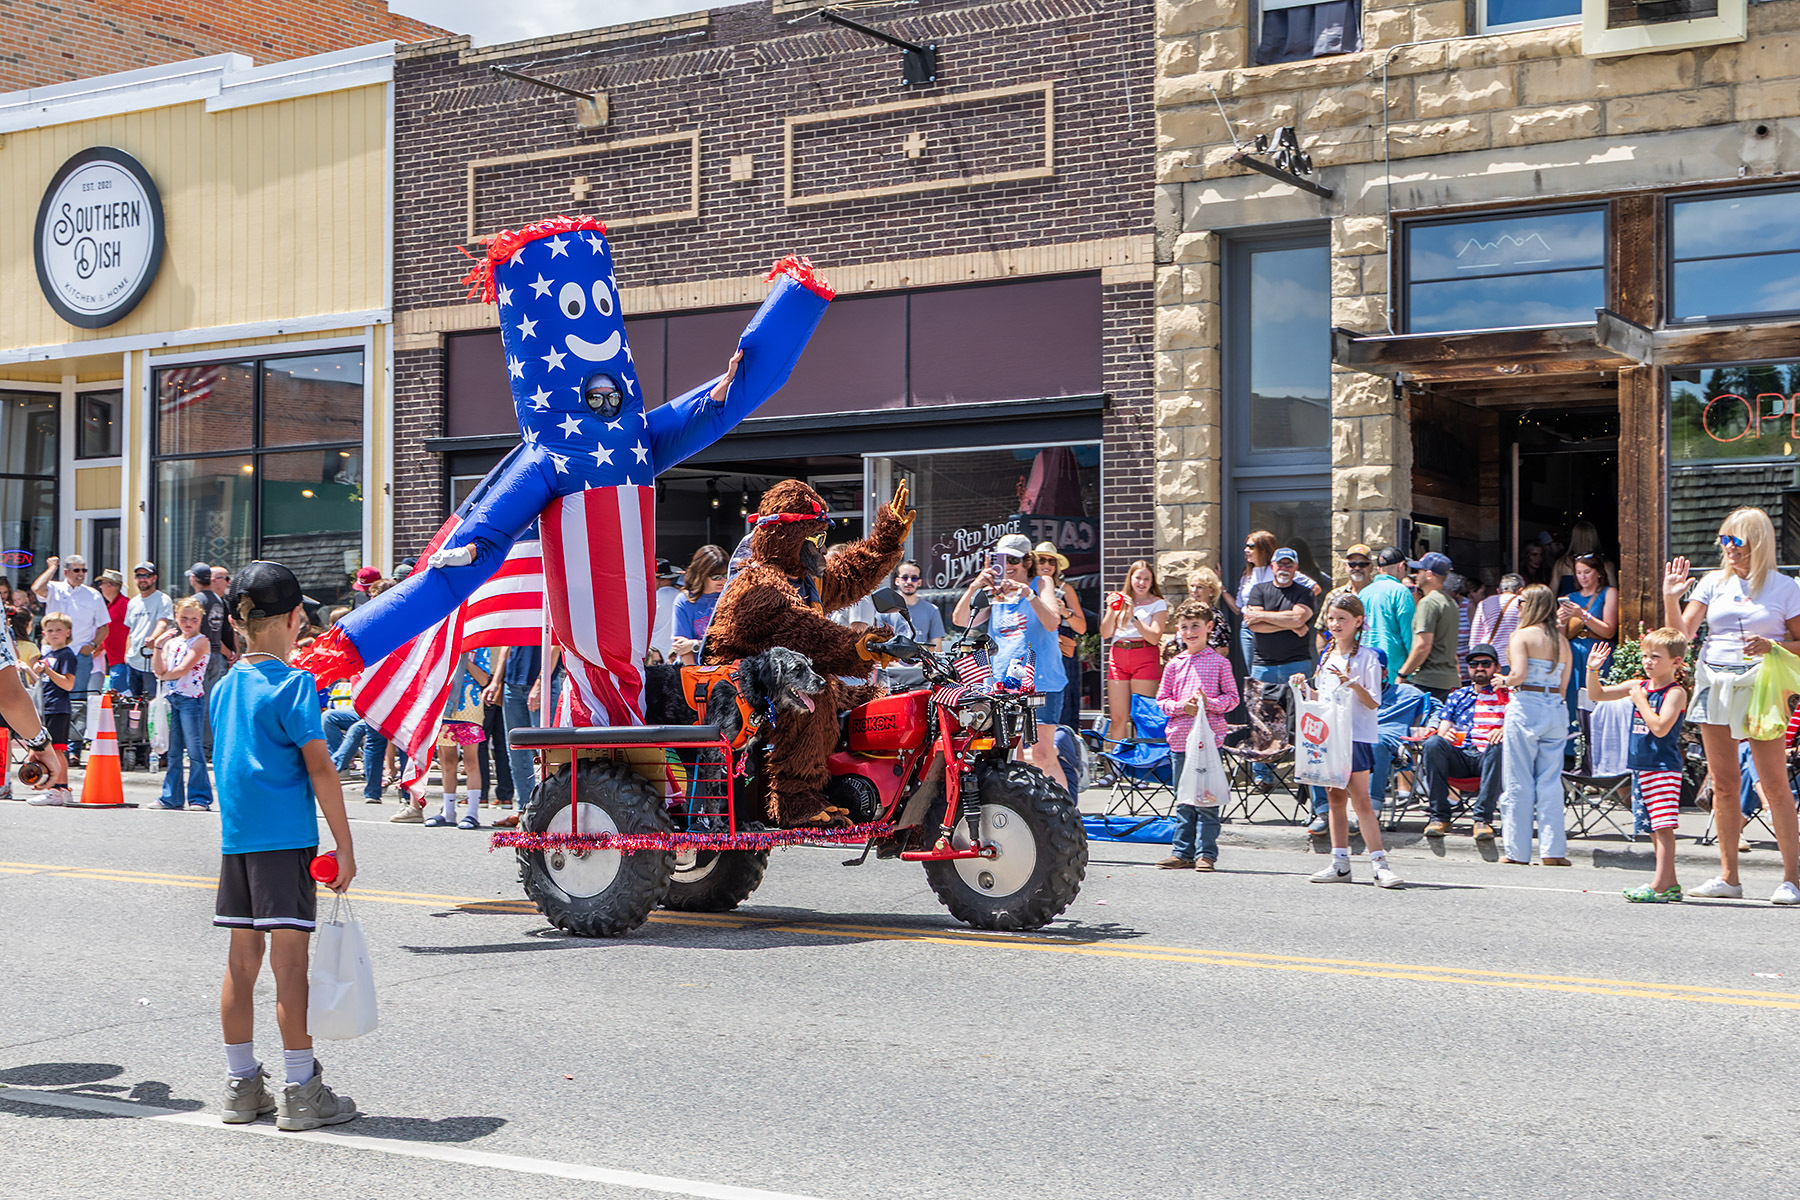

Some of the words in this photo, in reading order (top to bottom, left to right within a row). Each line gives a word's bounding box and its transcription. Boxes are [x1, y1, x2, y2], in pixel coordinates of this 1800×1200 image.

[82, 182, 95, 192] EST.
[97, 180, 112, 190] 2021
[53, 200, 141, 246] SOUTHERN
[74, 236, 121, 279] DISH
[64, 282, 96, 303] KITCHEN
[107, 276, 130, 300] HOME
[953, 528, 982, 555] RED
[982, 520, 1021, 546] LODGE
[852, 714, 896, 733] ROKON
